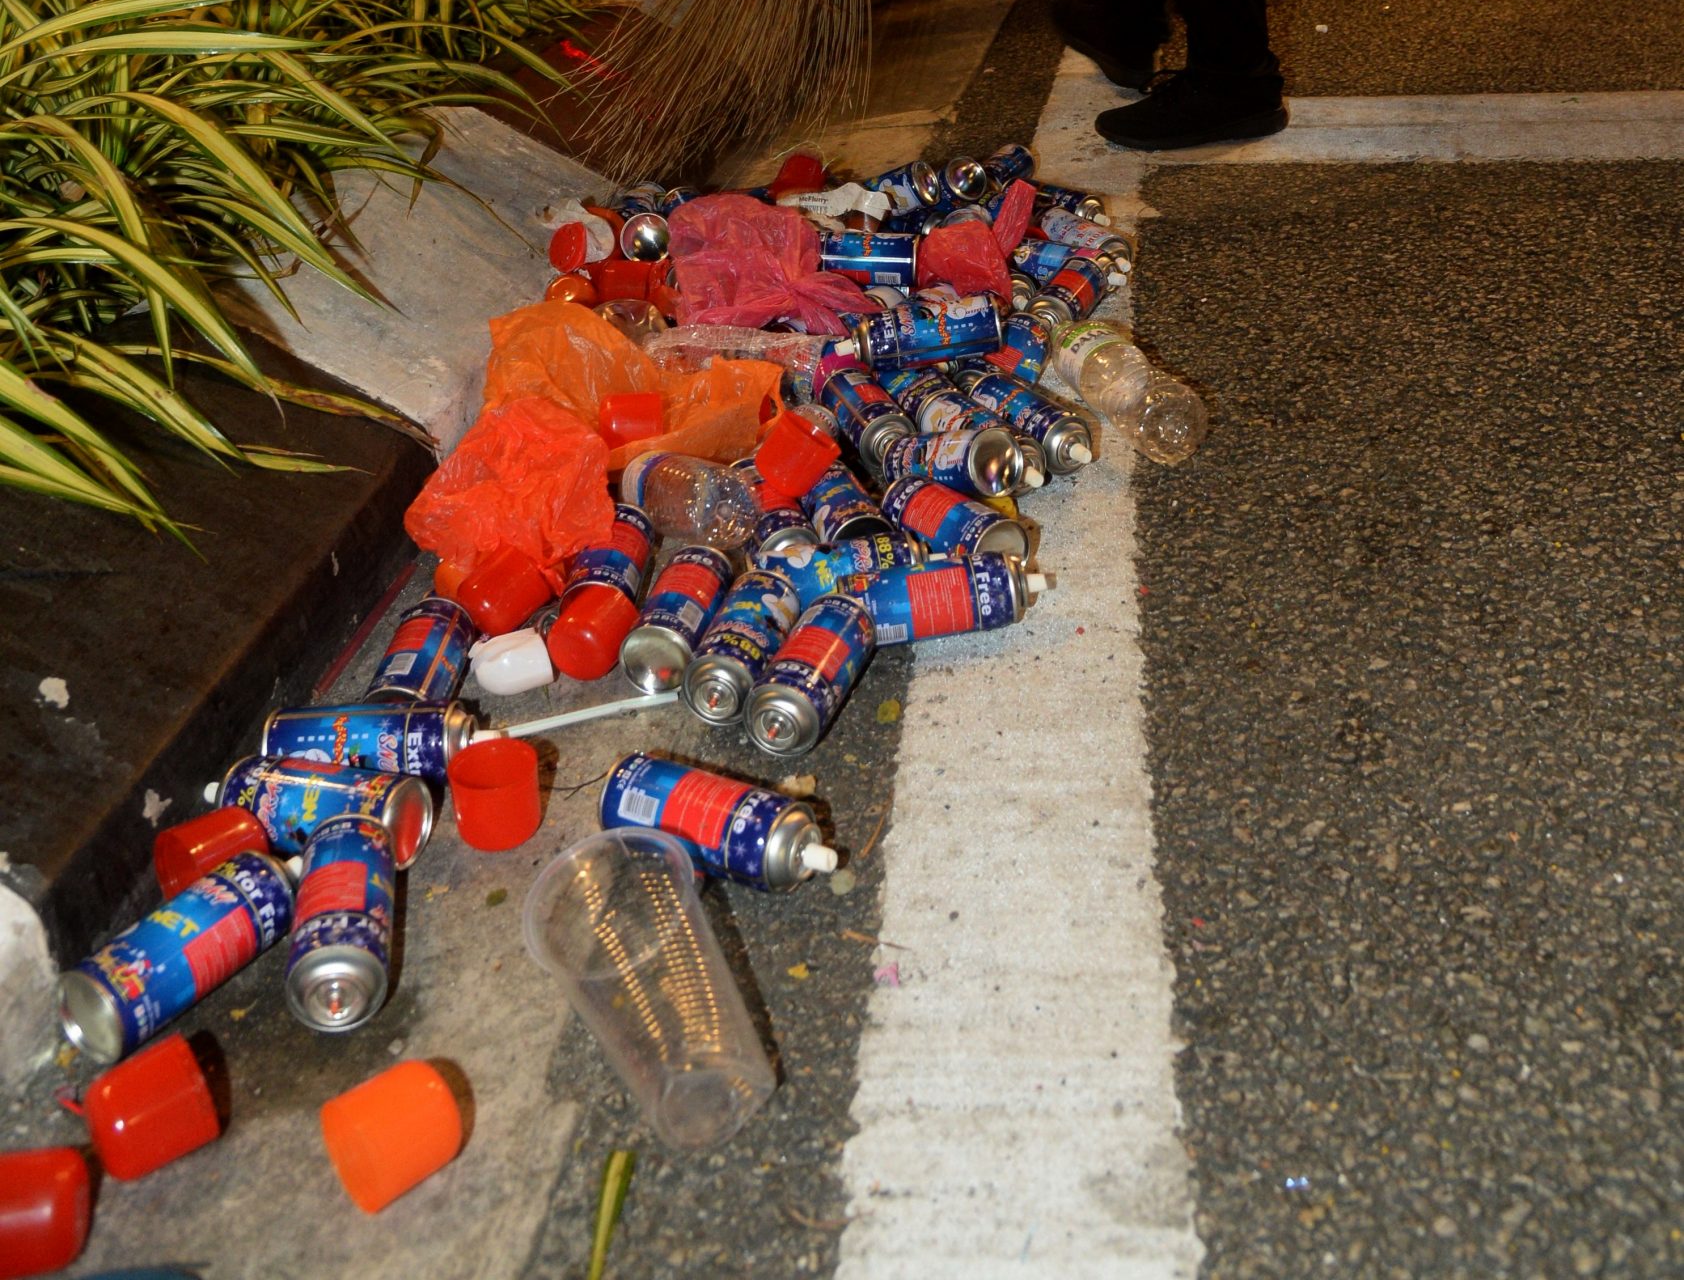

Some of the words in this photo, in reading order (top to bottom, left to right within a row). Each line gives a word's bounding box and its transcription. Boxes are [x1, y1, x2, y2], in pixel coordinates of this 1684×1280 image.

[893, 480, 925, 510] Free
[617, 512, 646, 531] ree
[673, 553, 713, 566] Free
[876, 536, 896, 570] 88%
[971, 554, 984, 568] or
[975, 571, 992, 616] Free
[722, 632, 761, 660] 88%
[774, 662, 818, 685] Free
[732, 790, 770, 835] Free
[234, 870, 263, 900] for
